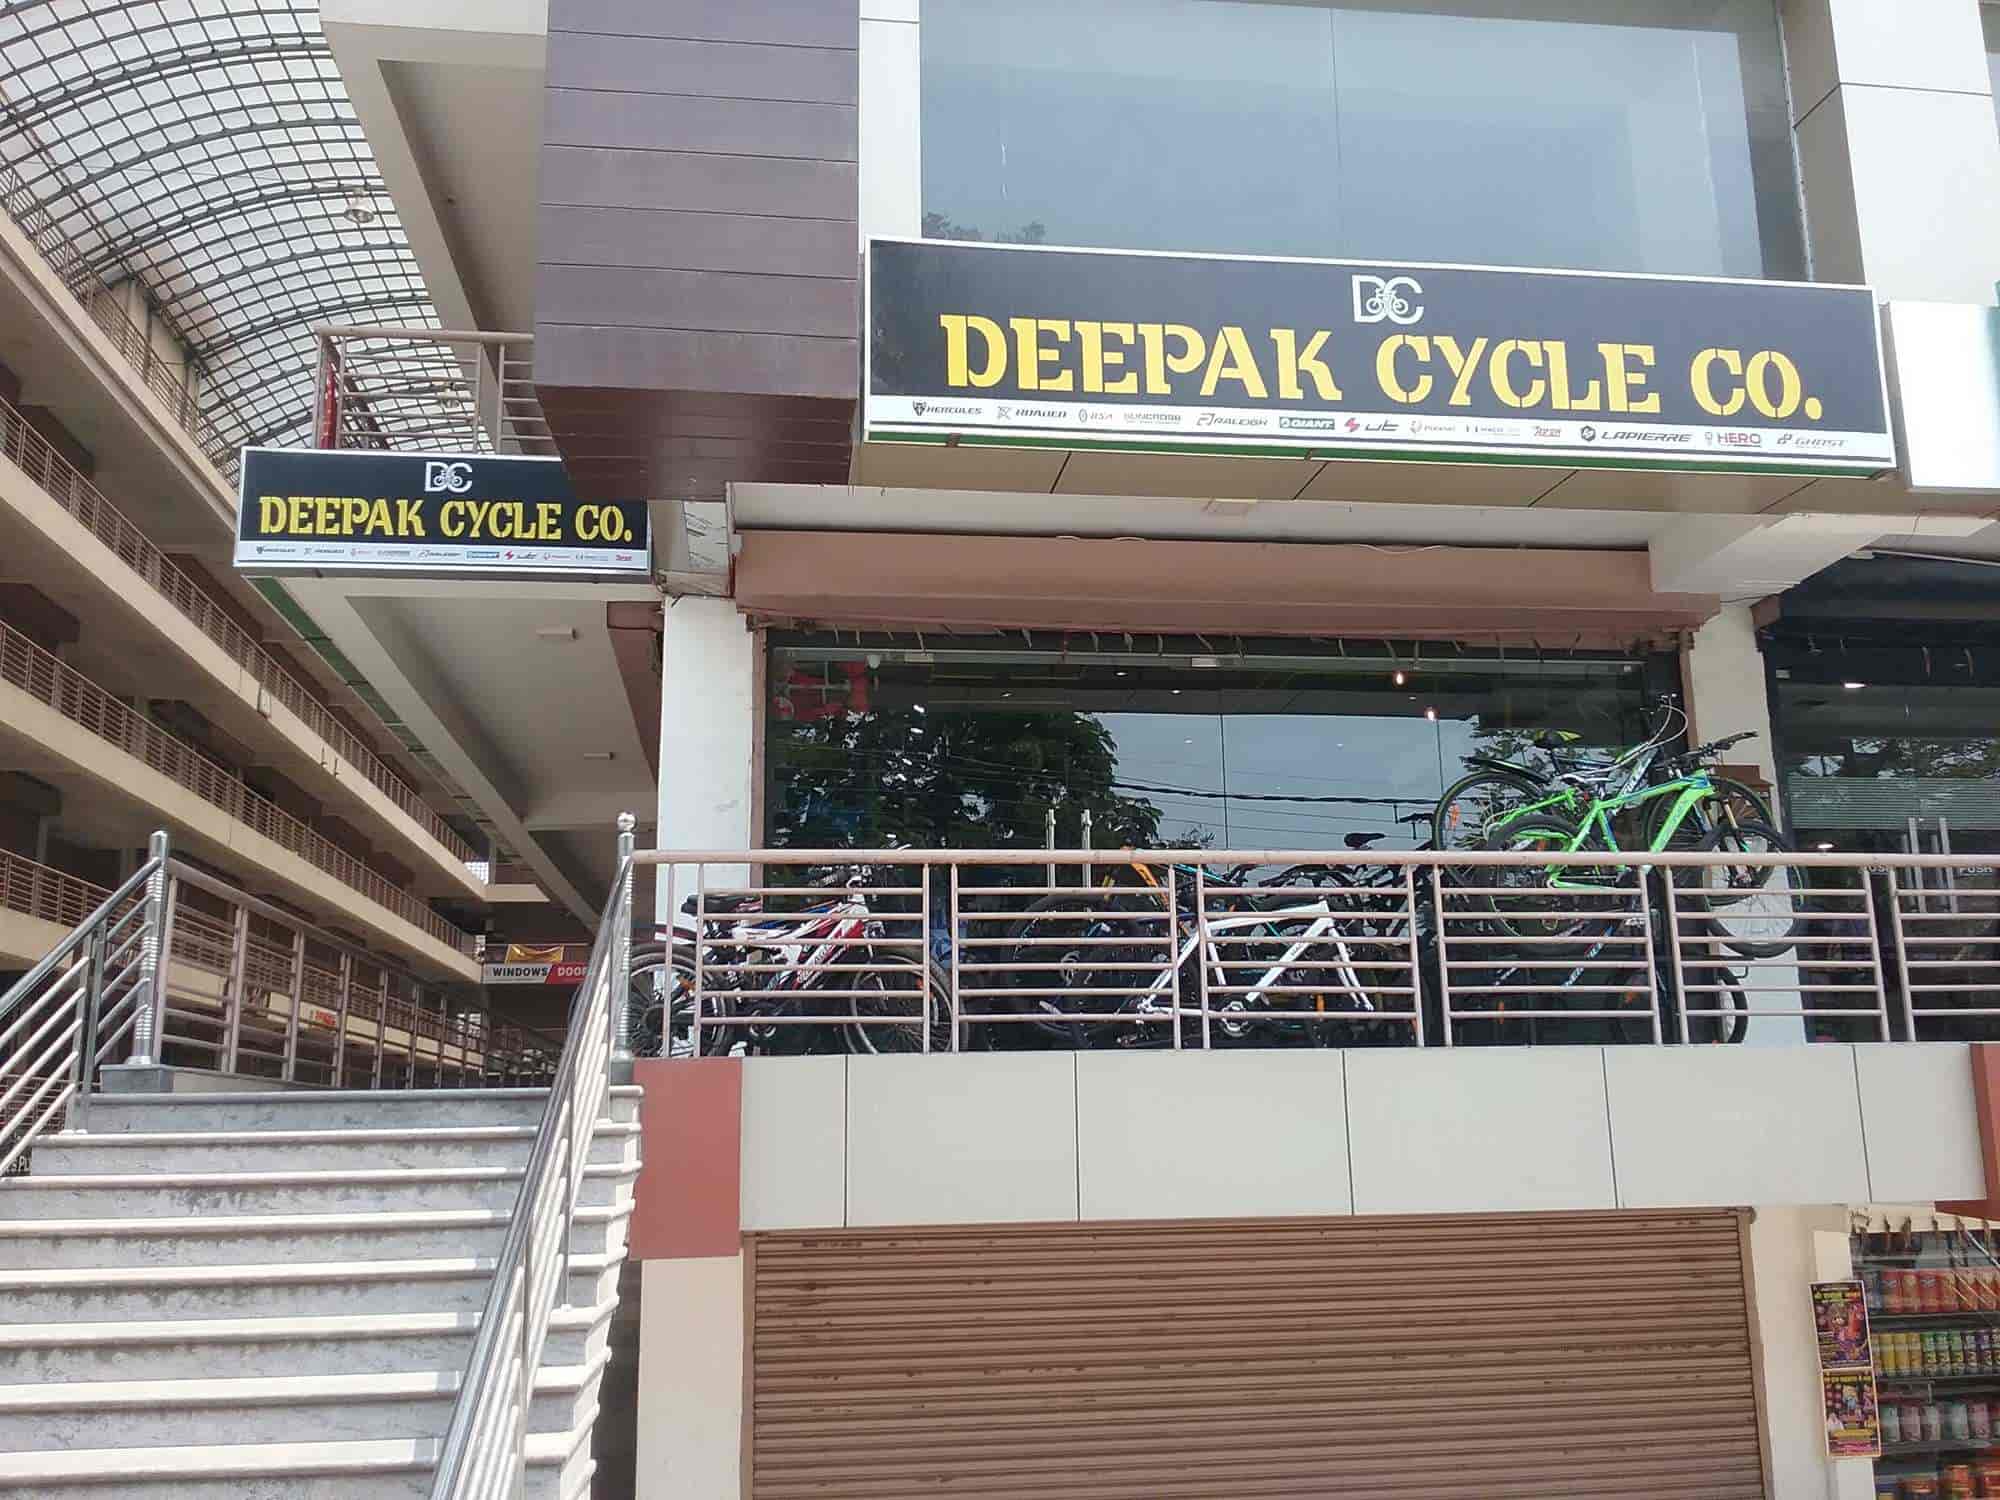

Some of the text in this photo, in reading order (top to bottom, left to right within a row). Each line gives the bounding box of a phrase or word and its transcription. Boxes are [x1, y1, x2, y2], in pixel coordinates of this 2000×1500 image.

[939, 314, 1822, 420] DEEPAK CYCLE CO.
[926, 405, 983, 415] HERCULES
[1213, 415, 1269, 427] RALEIGH
[1291, 419, 1334, 429] GIANT
[1600, 431, 1692, 443] LAPIERRE
[1717, 432, 1761, 444] HERO
[259, 496, 632, 542] DEEPAK CYCLE CO.
[492, 967, 548, 977] WINDOWS
